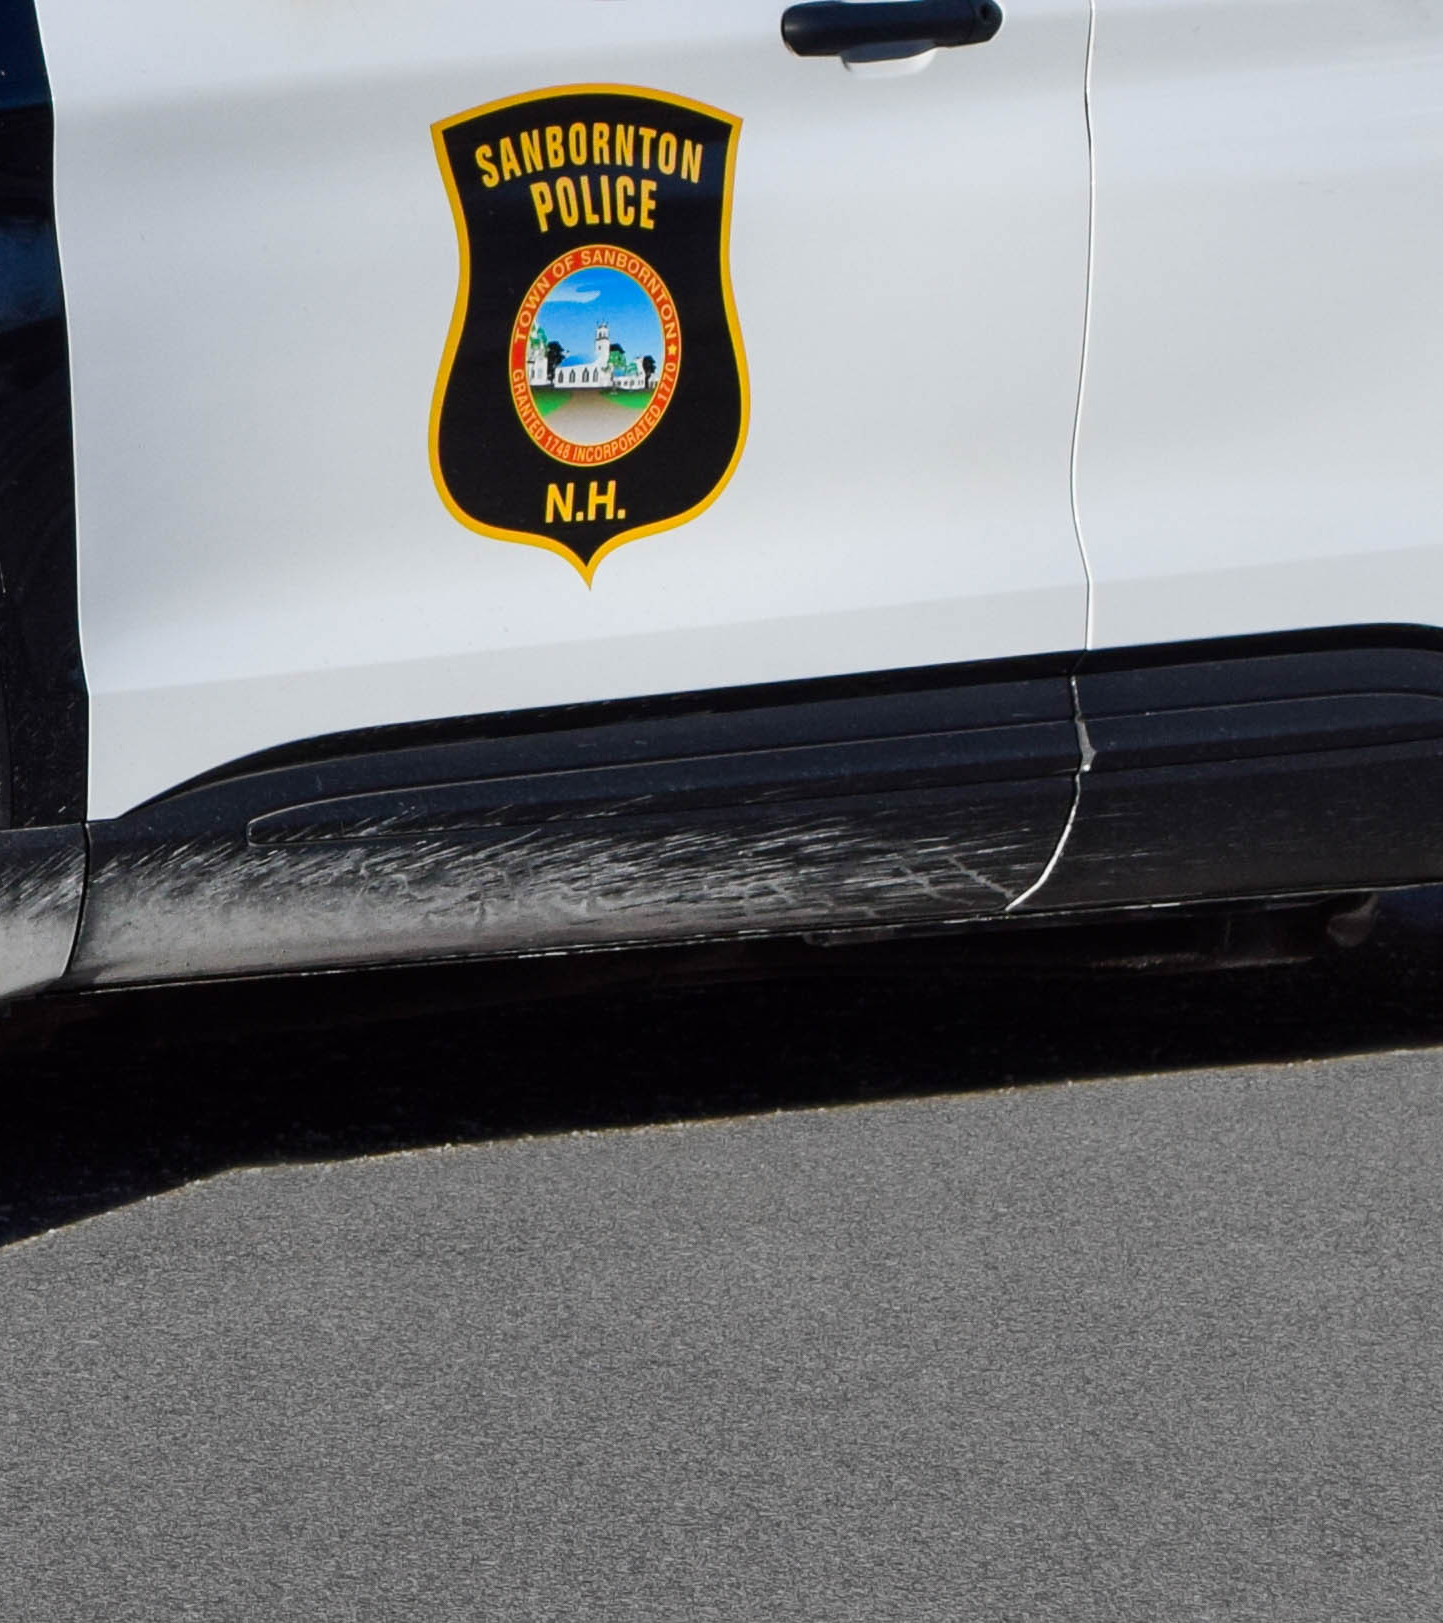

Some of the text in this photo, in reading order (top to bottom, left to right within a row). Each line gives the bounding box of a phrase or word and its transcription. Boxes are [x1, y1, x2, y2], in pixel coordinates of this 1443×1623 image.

[474, 121, 704, 189] SANBORNTON
[529, 175, 658, 233] POLICE
[514, 249, 677, 343] TOWN OF SANBORNTON
[512, 362, 676, 463] GRANTED 1748 INCORPORATED 1770
[545, 480, 626, 524] N.H.
